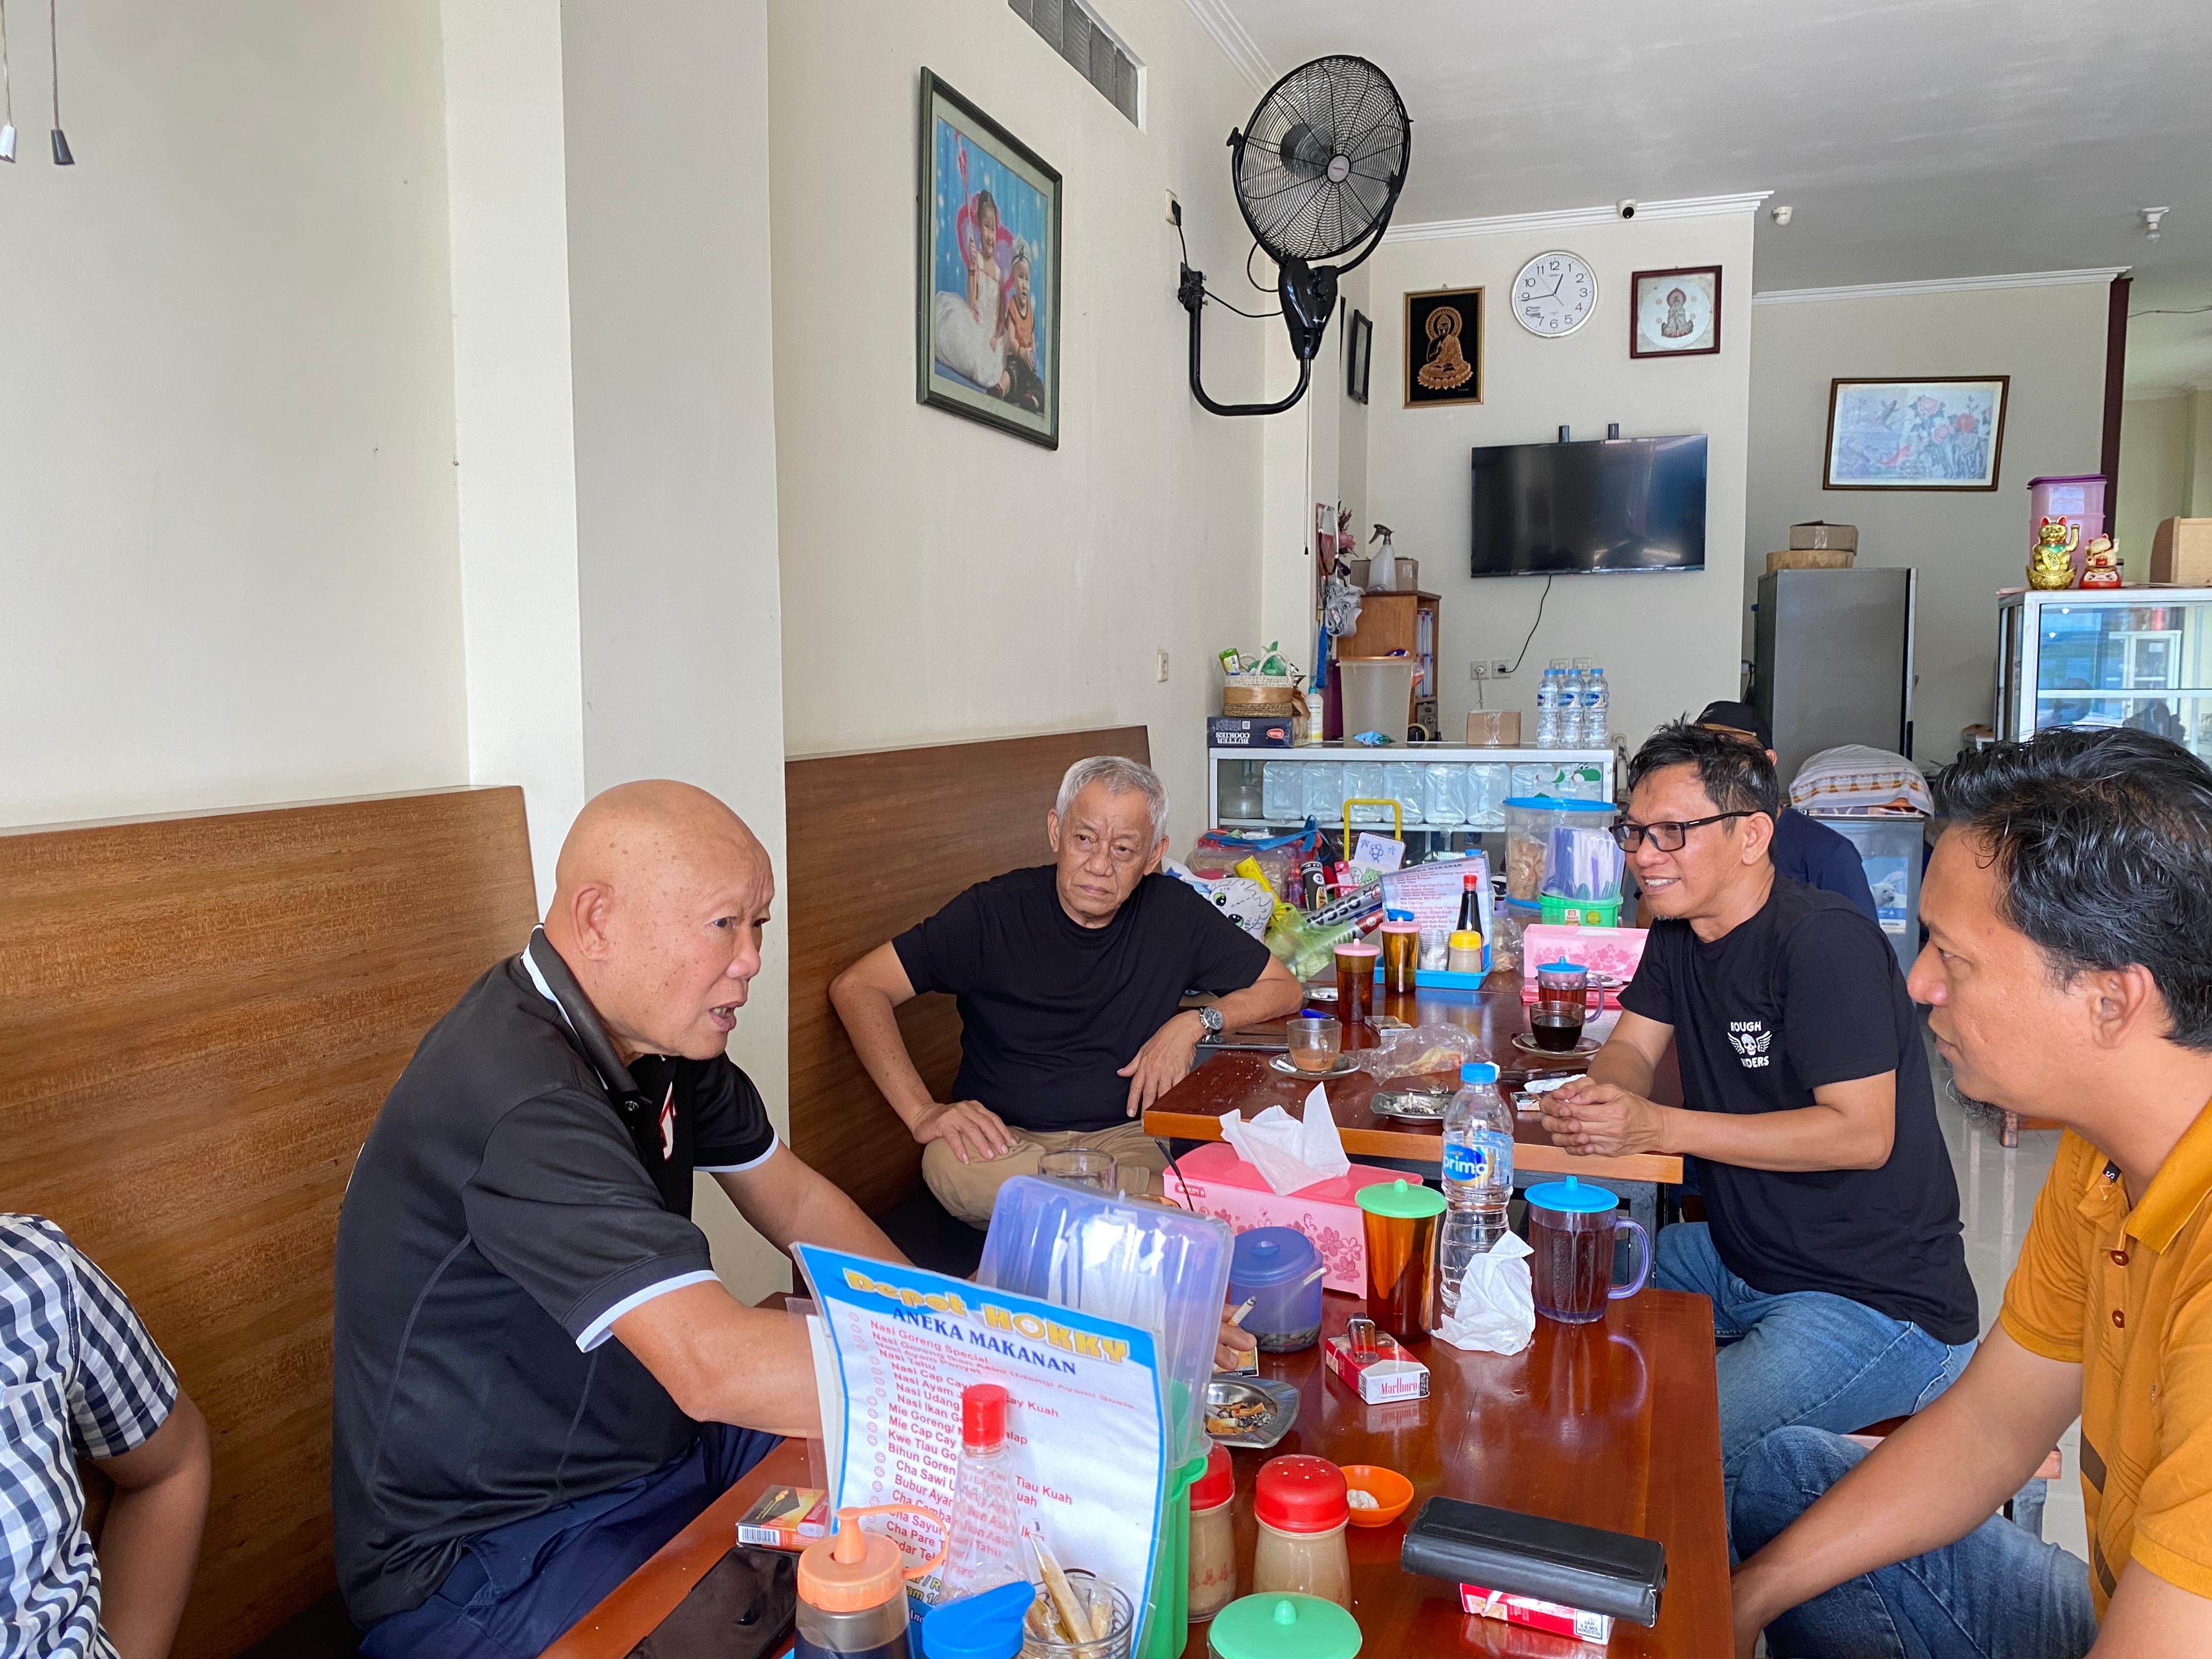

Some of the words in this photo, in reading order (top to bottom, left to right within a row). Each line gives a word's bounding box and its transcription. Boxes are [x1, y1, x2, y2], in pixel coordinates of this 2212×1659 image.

[1537, 266, 1544, 274] 11
[1549, 261, 1560, 270] 12
[1568, 263, 1571, 272] 1
[1526, 278, 1536, 287] 10
[1576, 273, 1584, 283] 2
[1522, 292, 1530, 301] 9
[1579, 288, 1587, 297] 3
[1575, 303, 1583, 312] 4
[1537, 317, 1544, 325] 7
[1550, 319, 1558, 329] 6
[1565, 314, 1572, 324] 5
[1741, 1056, 1769, 1068] DERS
[1443, 1155, 1488, 1175] prima
[845, 1268, 967, 1317] Depot
[982, 1304, 1129, 1364] HOKKY
[870, 1319, 895, 1335] Nasi
[899, 1329, 942, 1352] Goreng
[945, 1344, 989, 1364] Special
[872, 1331, 898, 1345] Nasi
[901, 1341, 945, 1359] Goreng
[893, 1307, 964, 1341] ANEKA
[970, 1330, 1076, 1375] MAKANAN
[879, 1348, 904, 1362] Nasi
[907, 1357, 936, 1370] Tahu
[891, 1362, 917, 1375] Nasi
[921, 1369, 943, 1383] Cap
[1027, 1401, 1059, 1418] Kuah
[893, 1372, 919, 1386] Nasi
[922, 1380, 953, 1396] Ayam
[1381, 1378, 1418, 1396] Marlboro
[895, 1382, 921, 1397] Nasi
[924, 1390, 960, 1412] Udang
[898, 1393, 922, 1409] Nasi
[925, 1402, 948, 1418] Ikan
[889, 1402, 908, 1417] Mie
[911, 1410, 955, 1434] Goreng/
[889, 1415, 907, 1429] Mie
[911, 1423, 933, 1439] Cap
[935, 1432, 957, 1448] Cay
[888, 1430, 911, 1445] Kwe
[914, 1438, 939, 1454] Tiau
[1015, 1474, 1039, 1493] Tiau
[1042, 1486, 1073, 1505] Kuah
[888, 1442, 919, 1462] Bihun
[1017, 1492, 1037, 1508] uah
[896, 1460, 917, 1476] Cha
[919, 1470, 946, 1488] Sawi
[894, 1474, 927, 1496] Bubur
[892, 1489, 912, 1505] Cha
[886, 1520, 908, 1537] Cha
[910, 1530, 935, 1546] Pare
[912, 1515, 943, 1535] Sayur
[1578, 1628, 1600, 1636] NIKOTIN
